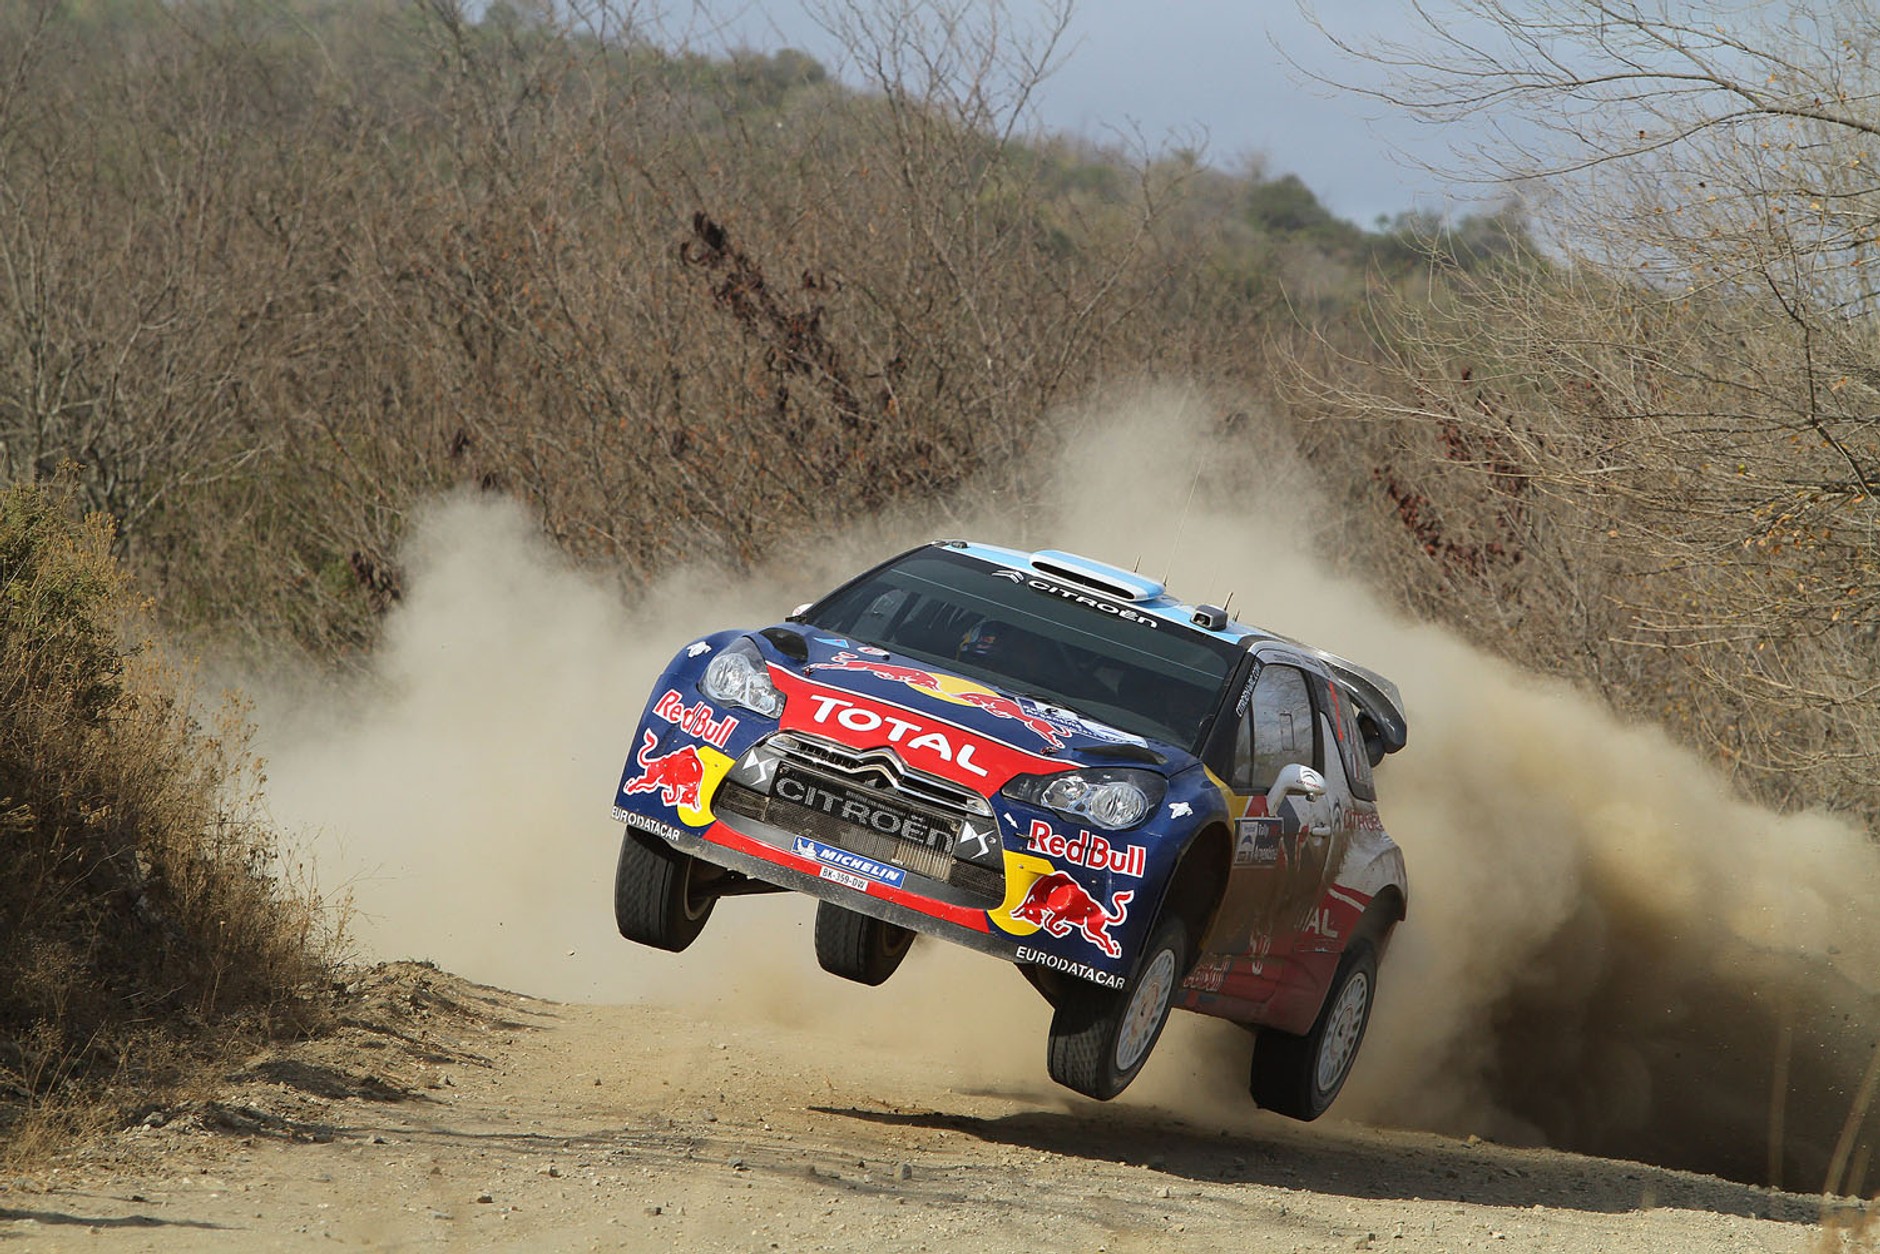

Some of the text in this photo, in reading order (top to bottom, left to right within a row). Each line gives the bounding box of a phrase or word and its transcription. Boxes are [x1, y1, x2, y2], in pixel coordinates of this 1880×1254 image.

[809, 695, 989, 777] TOTAL
[611, 806, 680, 841] EURODATACAR
[818, 848, 900, 882] MICHELIN
[821, 867, 867, 890] BK-359-DW
[1016, 946, 1126, 989] EURODATACAR
